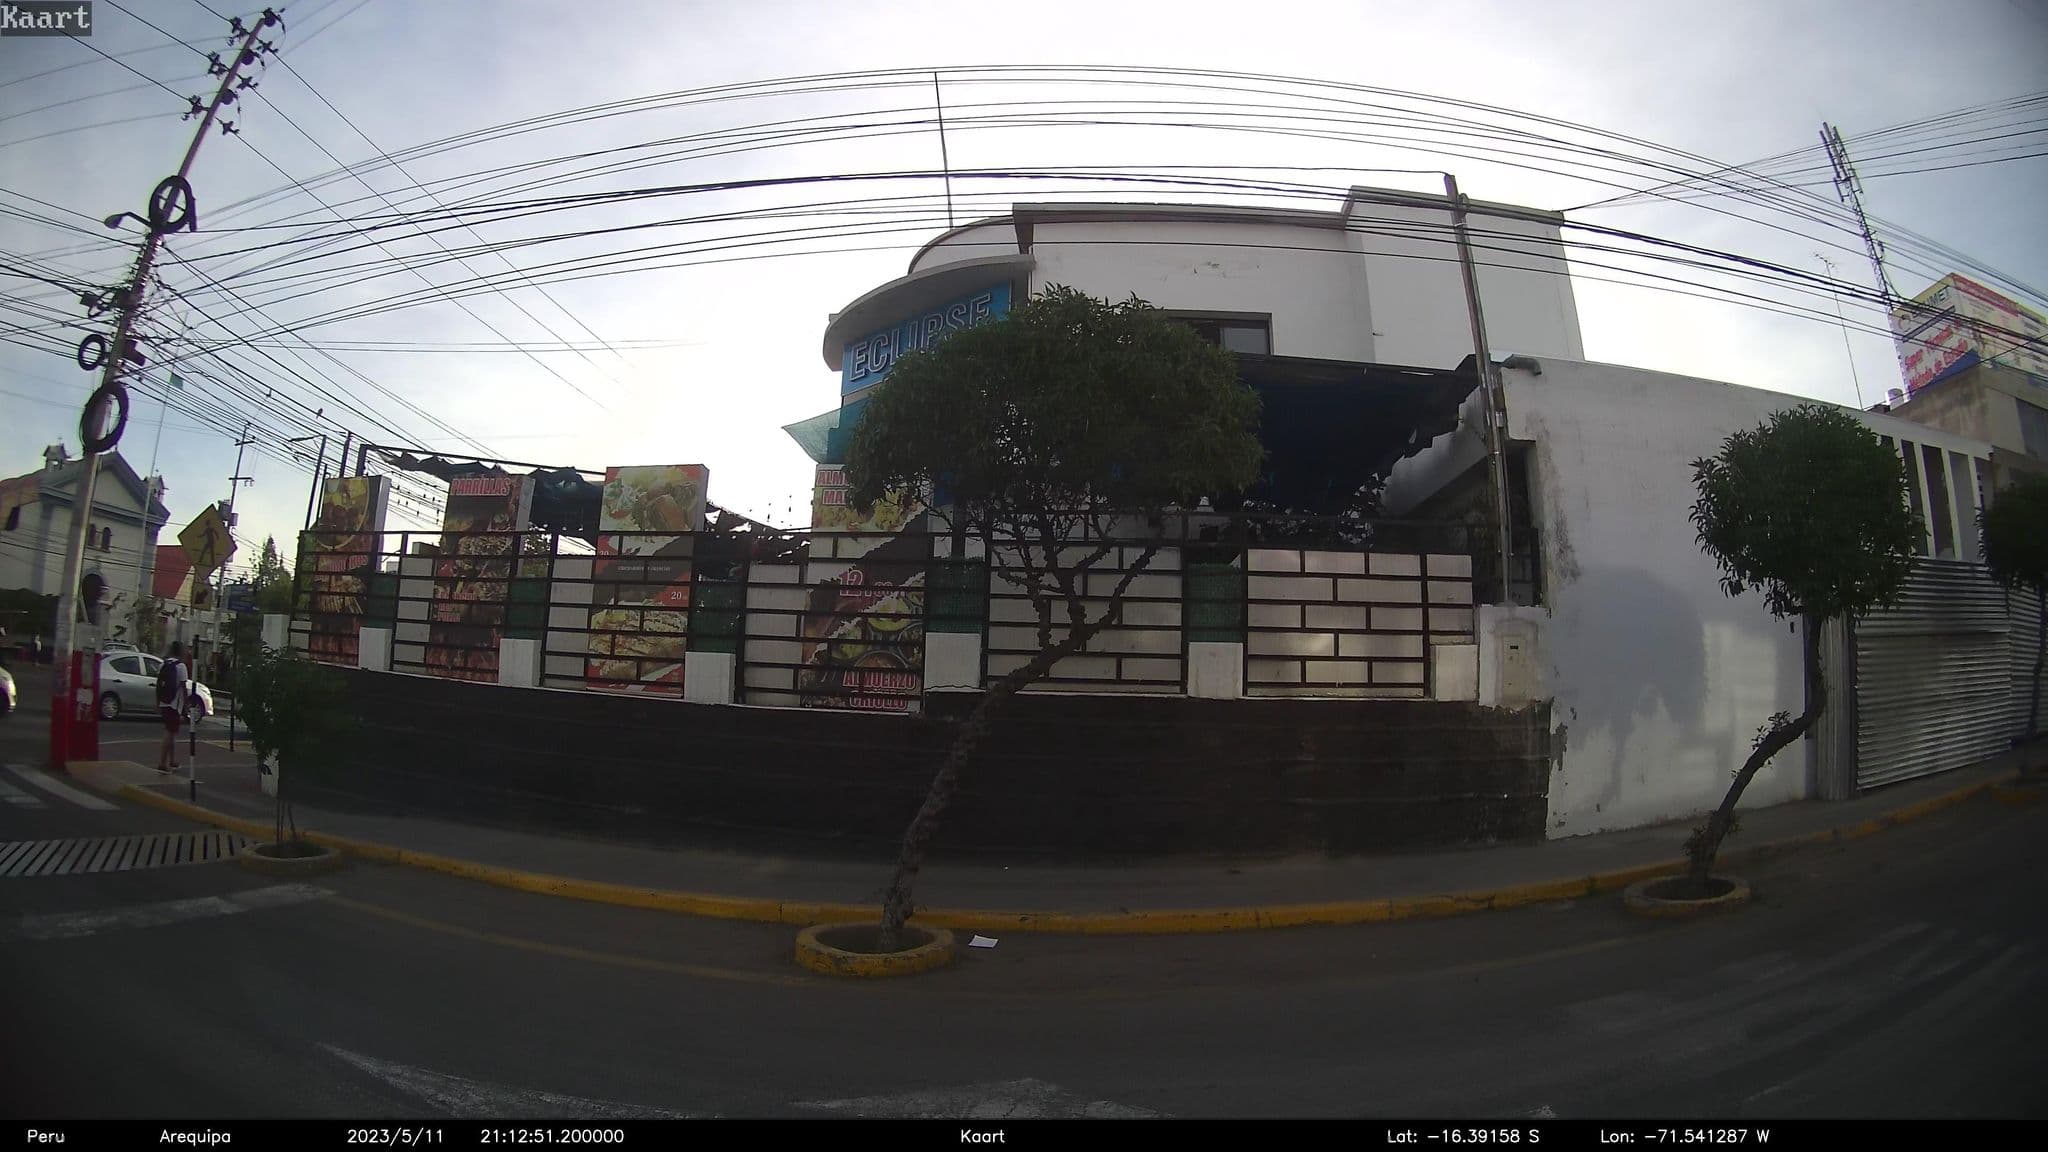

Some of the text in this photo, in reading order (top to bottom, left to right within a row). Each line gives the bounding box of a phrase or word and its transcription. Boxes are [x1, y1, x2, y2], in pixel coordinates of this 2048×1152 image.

[850, 293, 992, 381] ECLIPSE
[450, 478, 512, 496] PARRILLAS
[671, 591, 682, 600] 20
